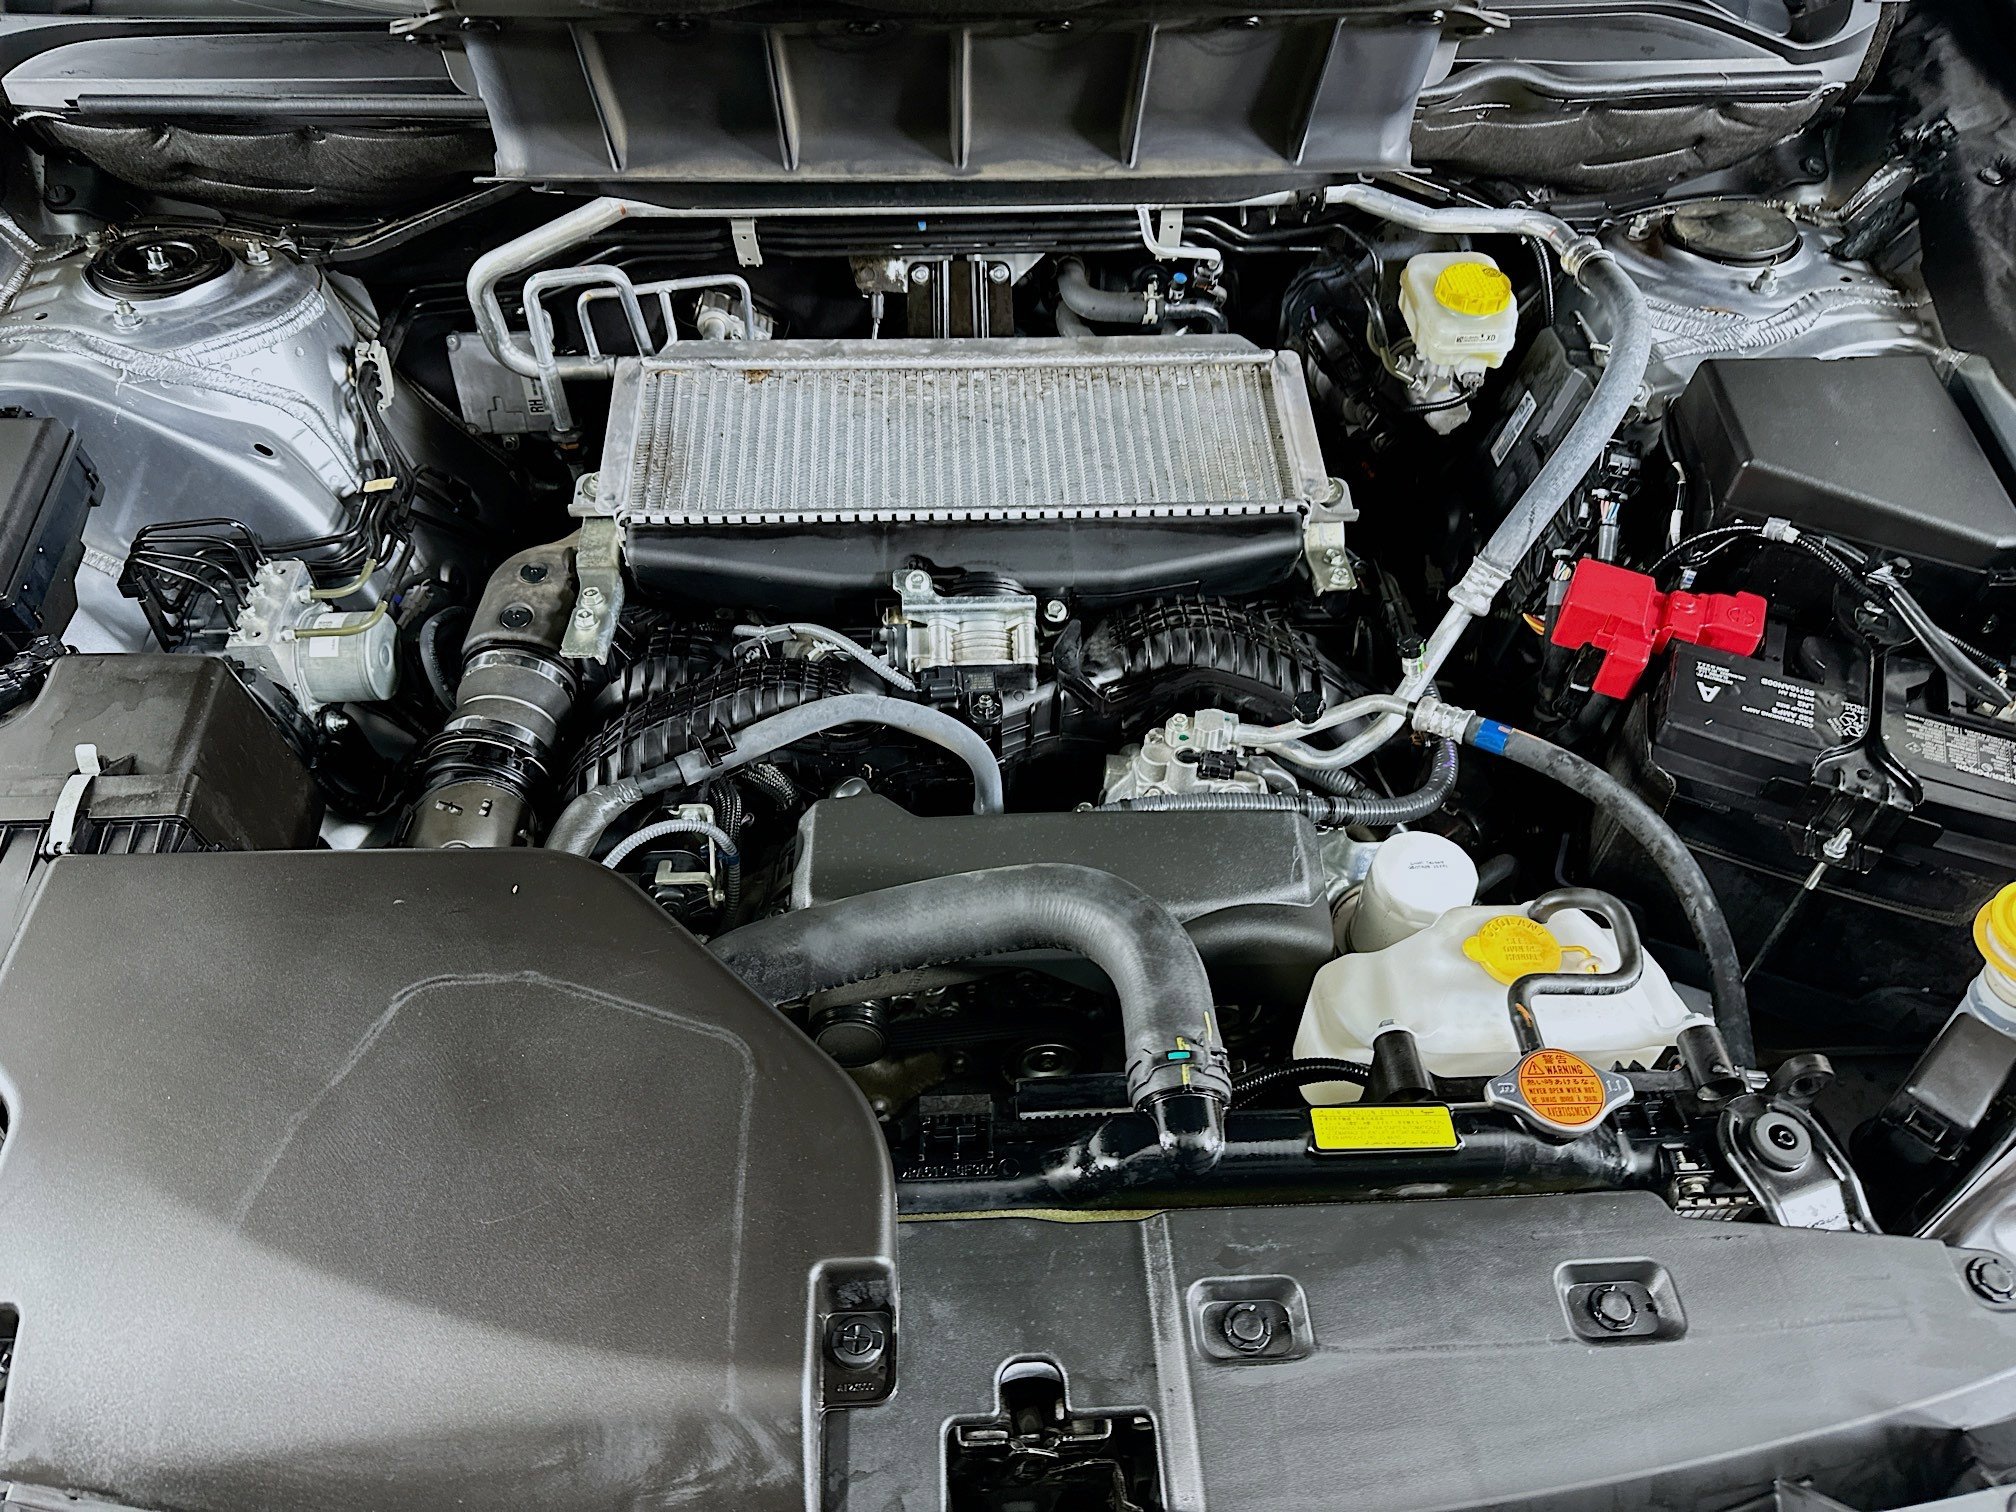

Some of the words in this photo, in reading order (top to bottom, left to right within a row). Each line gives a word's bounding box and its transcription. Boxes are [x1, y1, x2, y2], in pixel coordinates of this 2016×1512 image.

[528, 399, 545, 413] RH
[1741, 705, 1761, 715] AMPS
[1771, 706, 1797, 719] AMPS
[1795, 719, 1814, 729] COLD
[1482, 918, 1546, 937] COOLANT
[1542, 1054, 1567, 1064] 警告
[1545, 1064, 1584, 1075] WARNING
